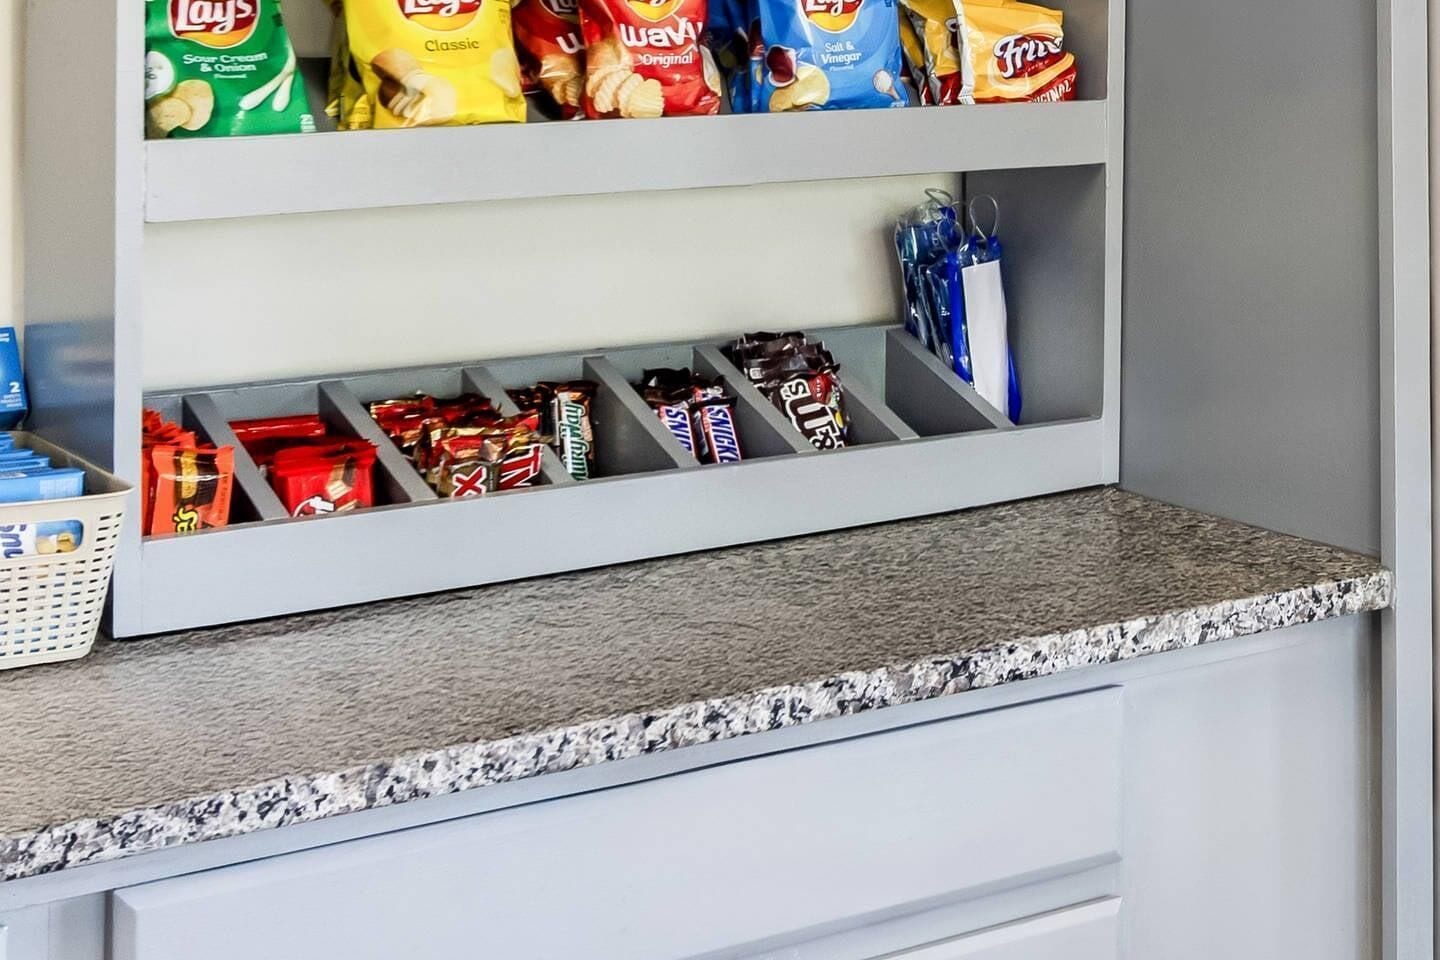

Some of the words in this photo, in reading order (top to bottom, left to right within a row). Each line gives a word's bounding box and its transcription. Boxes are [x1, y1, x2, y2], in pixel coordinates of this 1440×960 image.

[424, 38, 480, 53] Classic
[825, 41, 844, 53] Salt
[846, 41, 855, 51] &
[183, 54, 218, 64] Sour
[220, 52, 268, 63] Cream
[643, 52, 693, 68] Original
[820, 52, 862, 65] Vinegar
[200, 63, 213, 72] &
[214, 62, 256, 72] Onion
[9, 381, 21, 394] 2
